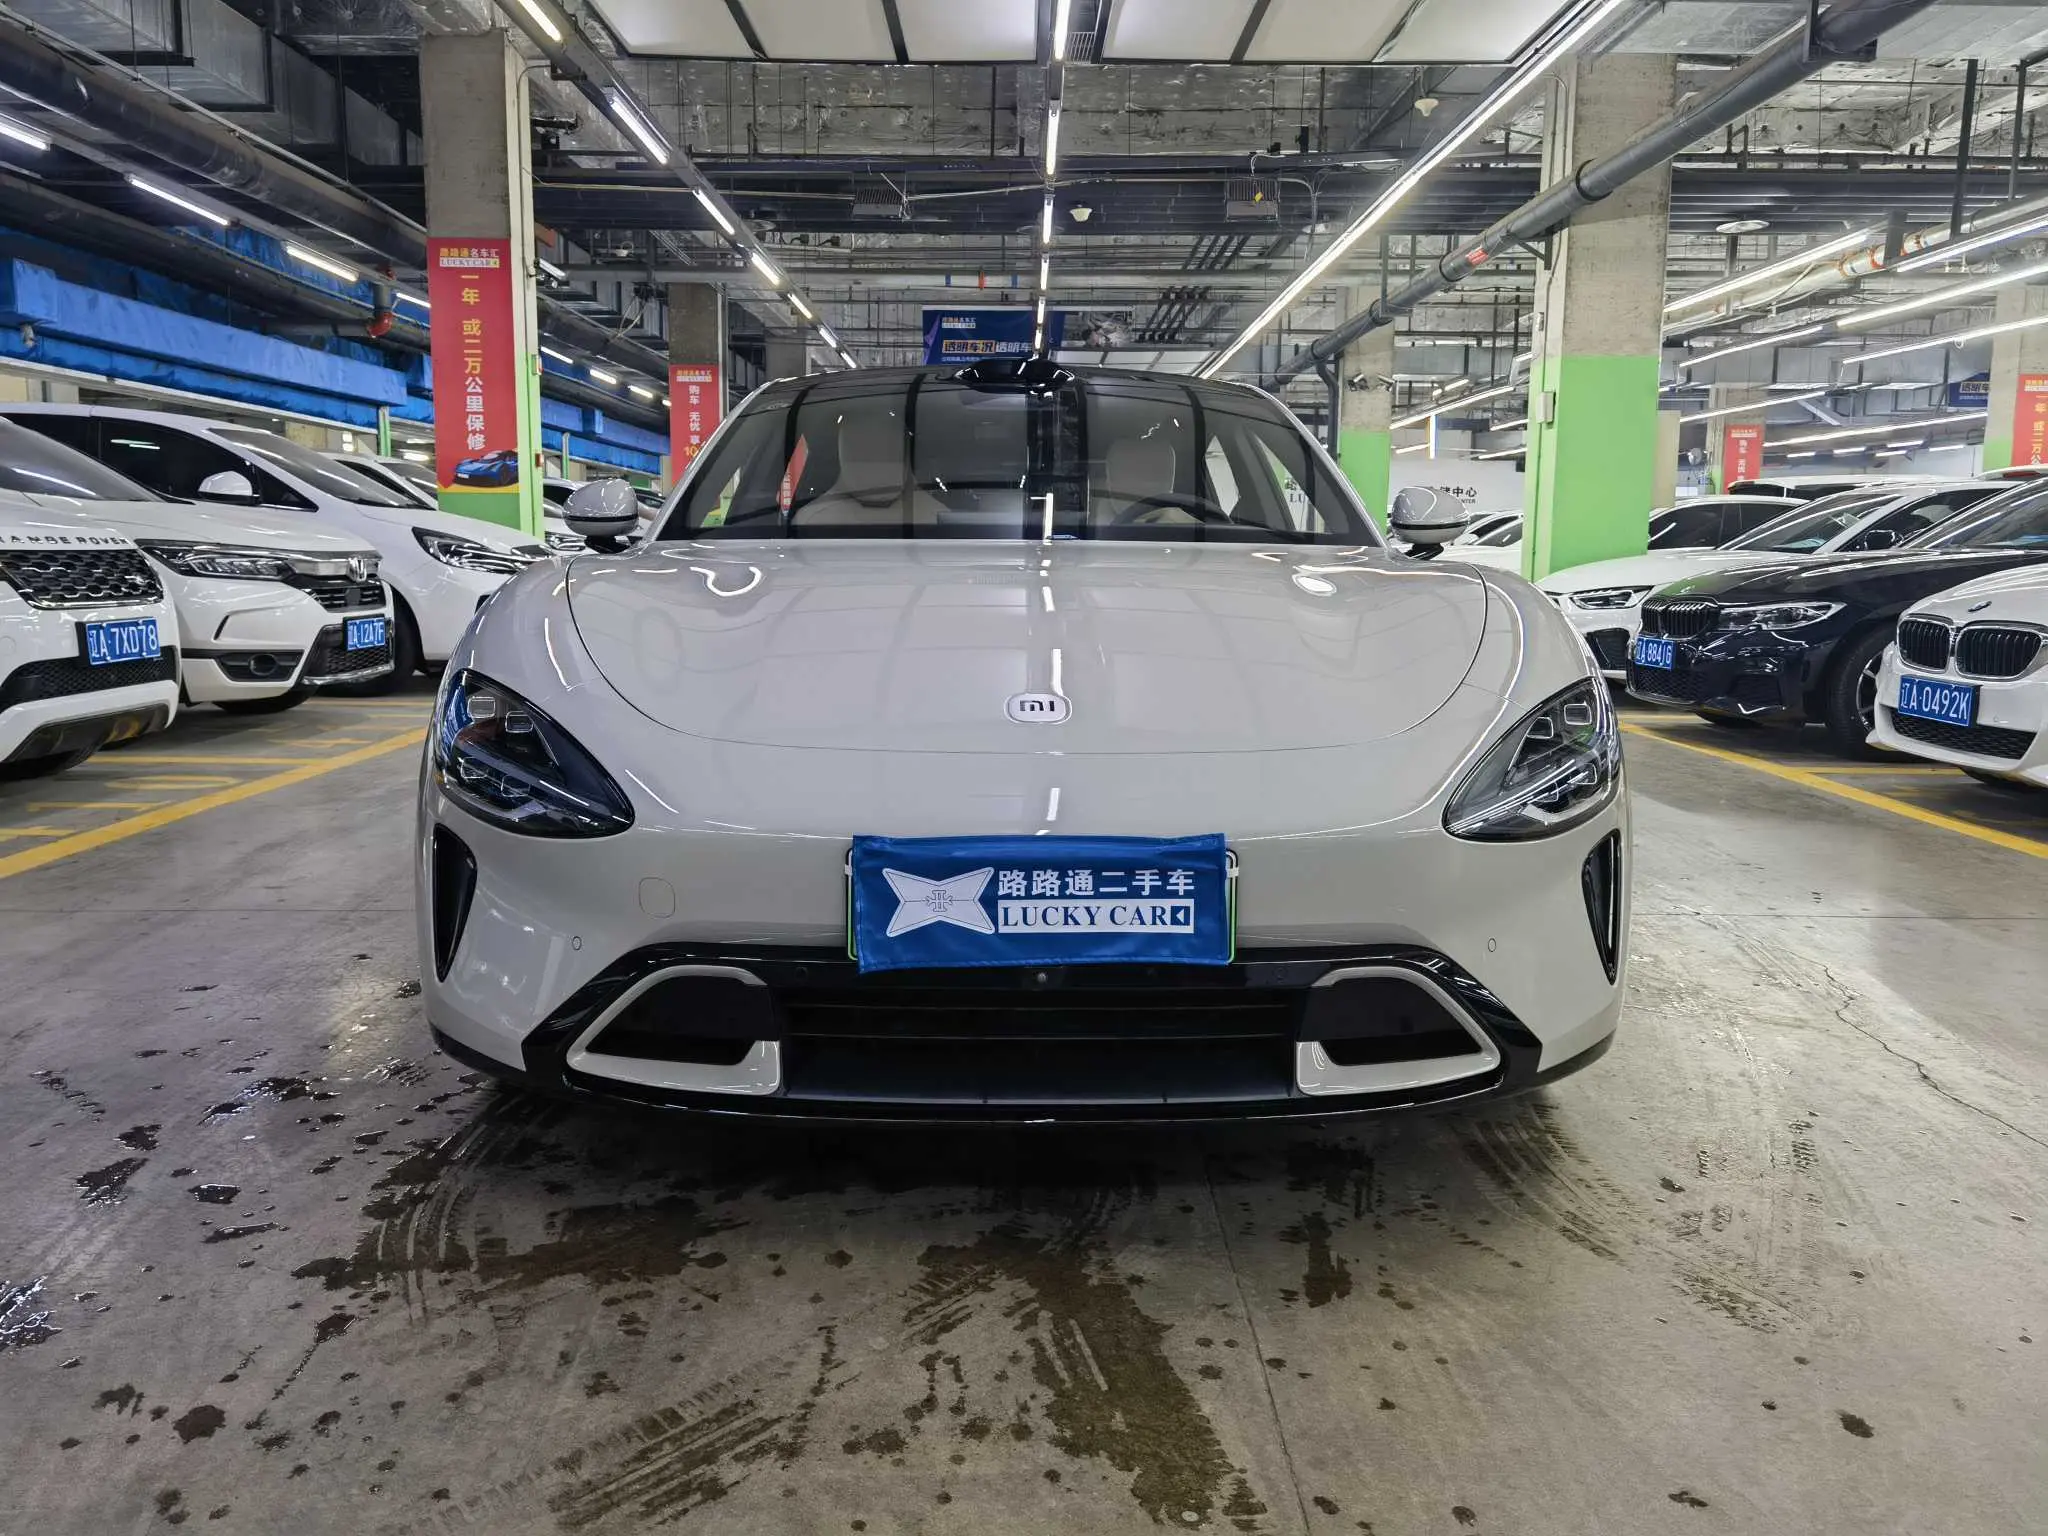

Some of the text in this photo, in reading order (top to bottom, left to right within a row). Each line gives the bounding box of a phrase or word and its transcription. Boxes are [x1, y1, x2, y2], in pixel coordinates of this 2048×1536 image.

[998, 869, 1195, 896] 路路通二手车
[1001, 904, 1170, 927] LUCKY CAR
